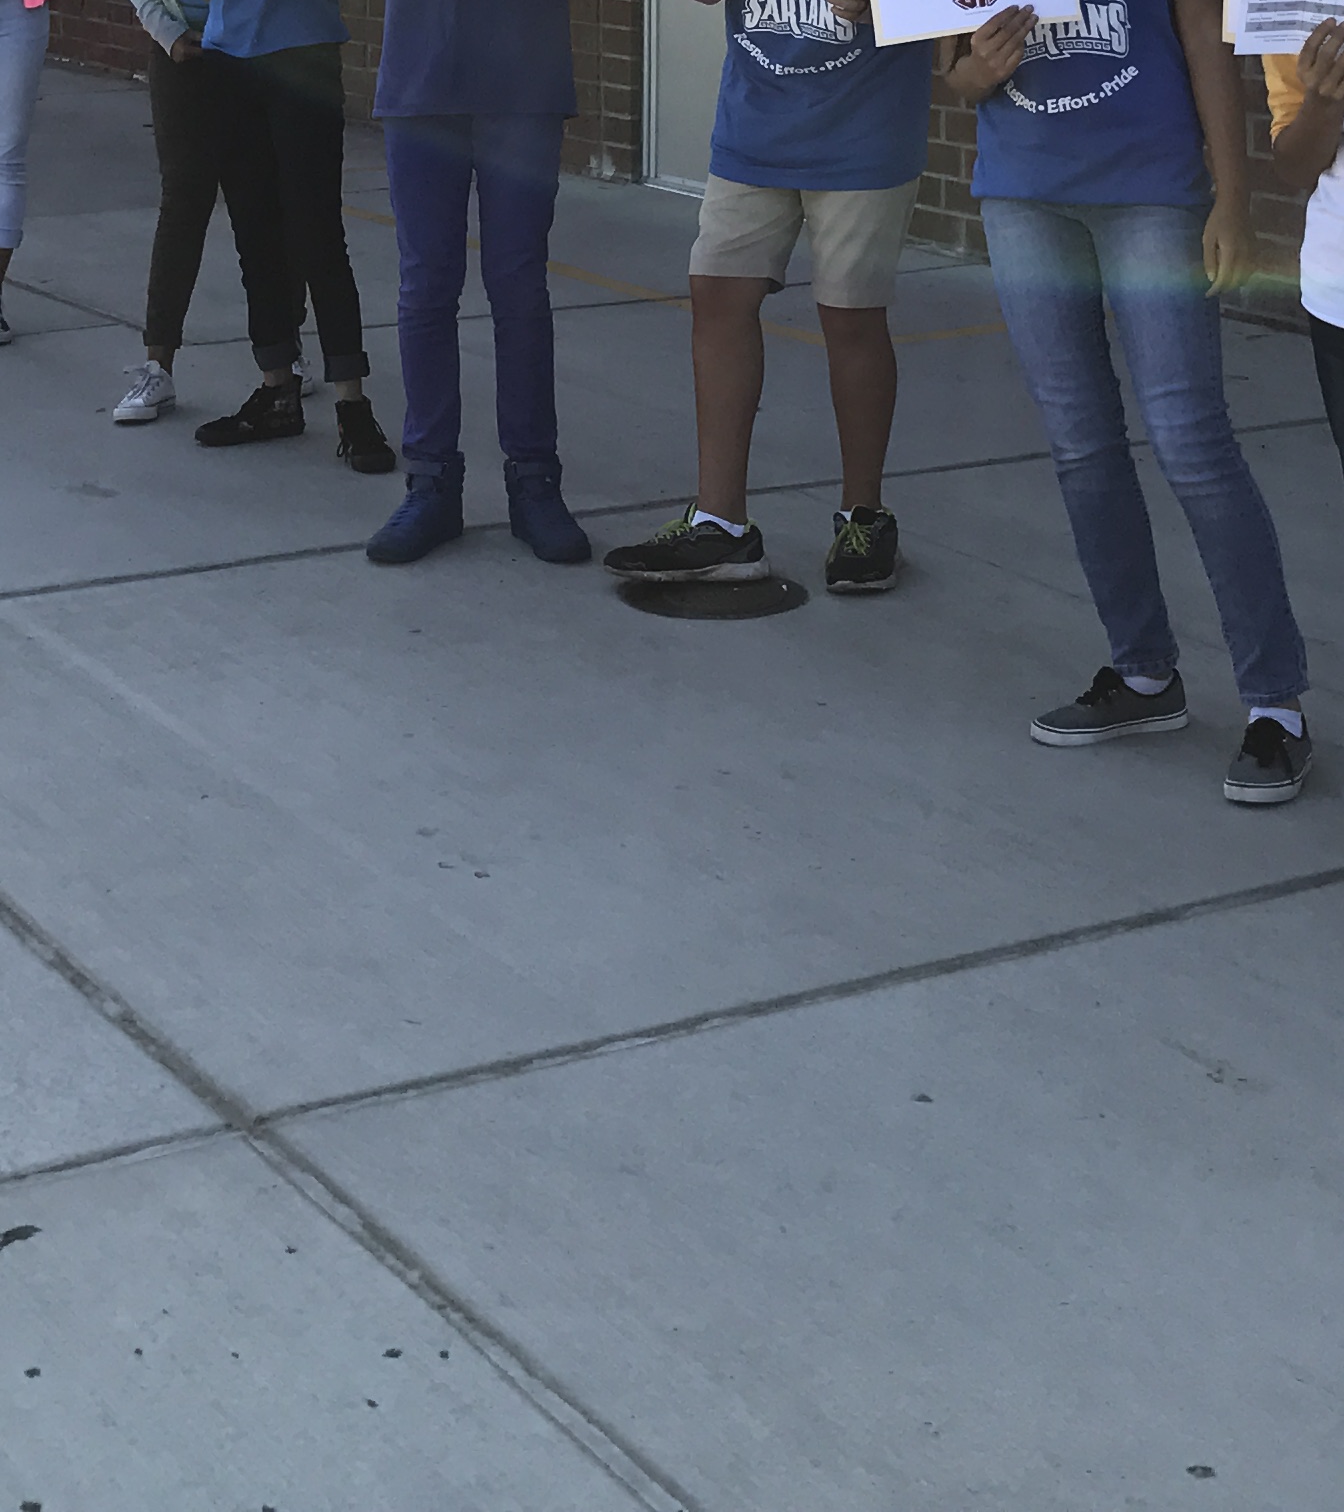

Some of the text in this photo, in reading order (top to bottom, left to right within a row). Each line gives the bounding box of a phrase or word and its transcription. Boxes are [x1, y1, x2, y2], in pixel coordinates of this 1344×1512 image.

[825, 48, 862, 71] Pride
[1047, 93, 1100, 114] Effort
[1101, 65, 1139, 96] Pride
